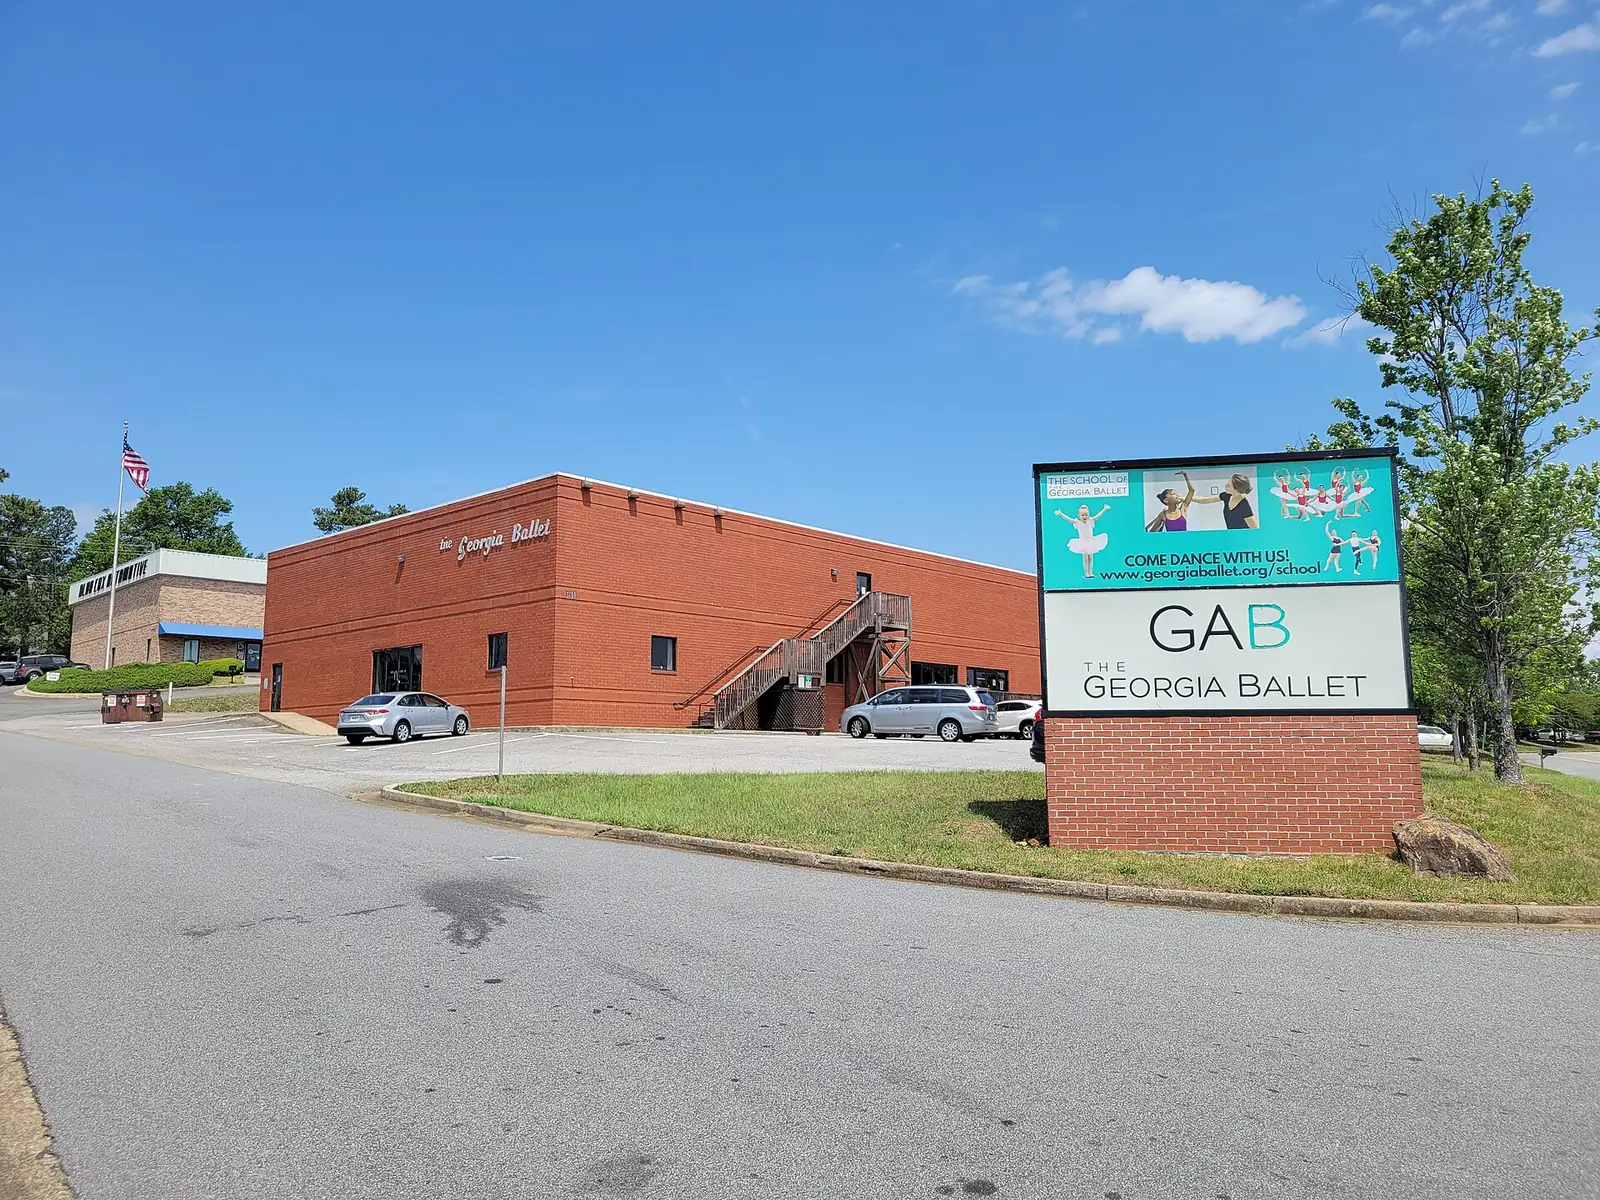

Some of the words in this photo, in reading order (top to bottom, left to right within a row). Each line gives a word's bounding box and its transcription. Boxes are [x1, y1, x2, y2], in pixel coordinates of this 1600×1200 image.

[1048, 477, 1069, 485] THE
[1070, 475, 1114, 484] SCHOOL
[1049, 488, 1091, 497] GEORGIA
[1093, 487, 1128, 495] BALLET
[457, 530, 504, 561] Georgia
[511, 518, 551, 543] Ballet
[1124, 554, 1167, 567] COME
[1170, 552, 1220, 565] DANCE
[1222, 551, 1262, 564] WITH
[1265, 549, 1290, 562] US!
[106, 559, 149, 588] ATOMOTIVE
[1100, 561, 1320, 582] www.georgiaballet.org/school
[1149, 603, 1291, 653] GAB
[1084, 661, 1126, 673] THE
[1083, 675, 1227, 699] GEORGIA
[1238, 673, 1367, 698] BALLET
